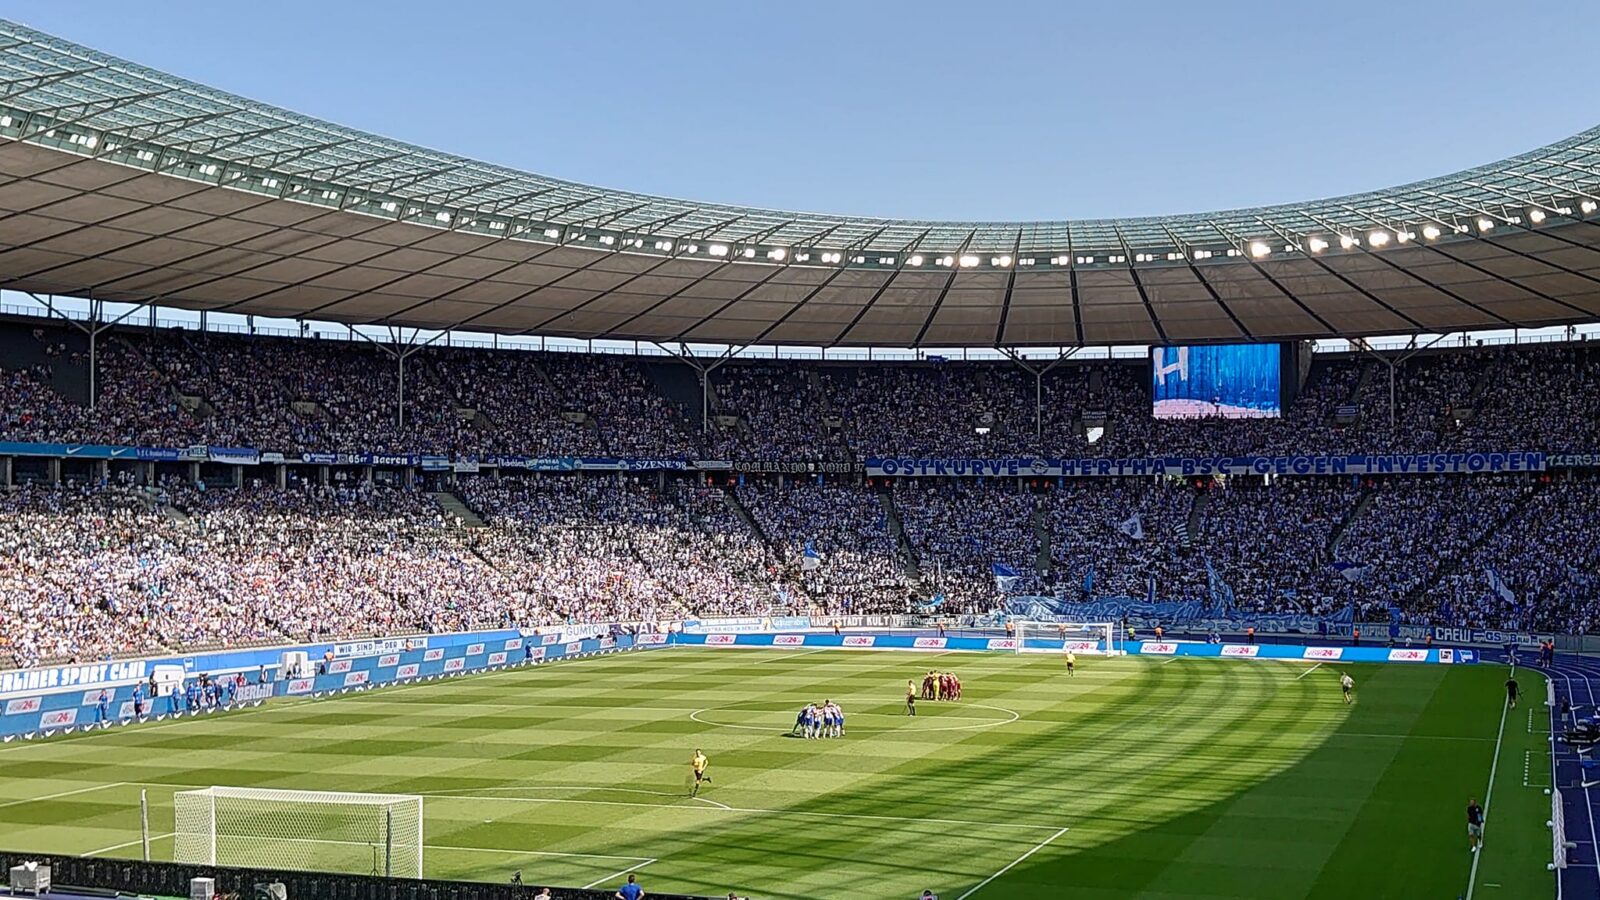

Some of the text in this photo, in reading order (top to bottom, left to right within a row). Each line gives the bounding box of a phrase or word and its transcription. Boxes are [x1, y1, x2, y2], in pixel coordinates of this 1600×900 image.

[881, 452, 1543, 476] OSTKURVE HERTHA BSC GEGEN INVESTOREN
[1435, 627, 1471, 642] CREW
[60, 664, 108, 686] SPORT
[109, 660, 147, 681] CLUB
